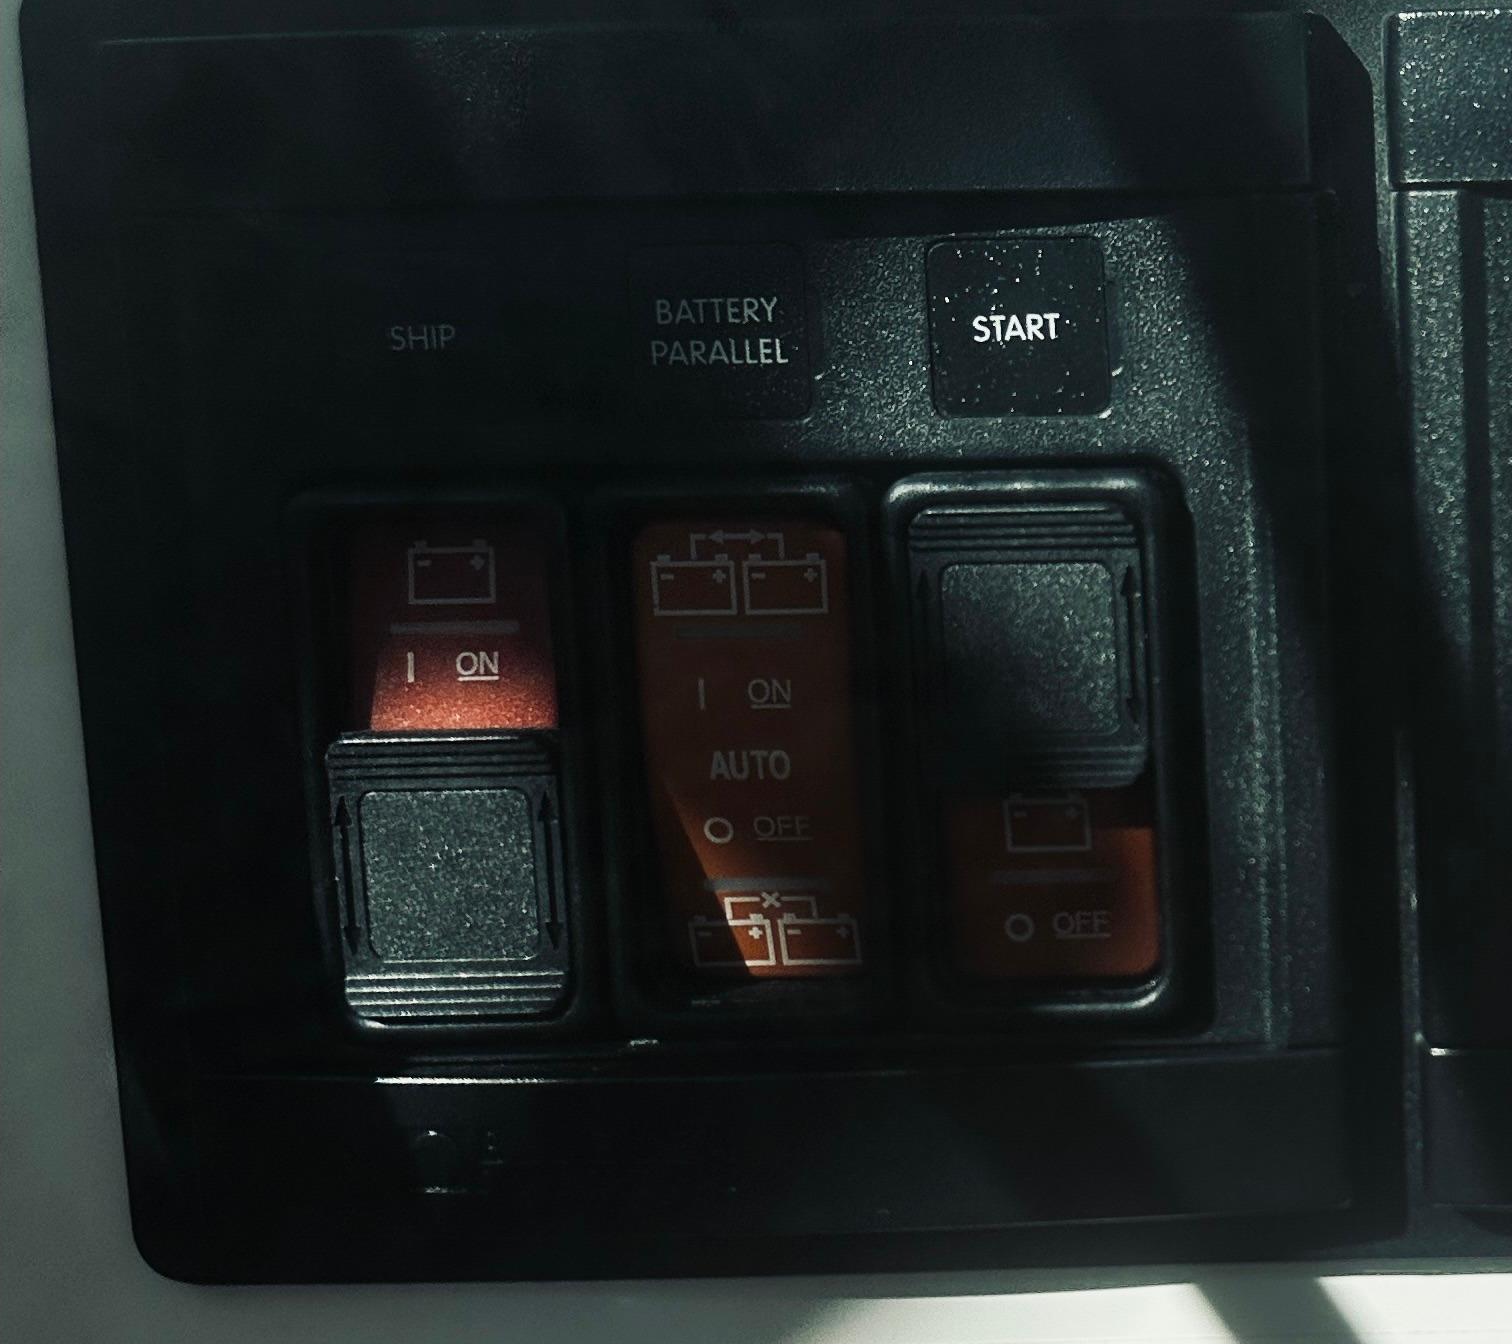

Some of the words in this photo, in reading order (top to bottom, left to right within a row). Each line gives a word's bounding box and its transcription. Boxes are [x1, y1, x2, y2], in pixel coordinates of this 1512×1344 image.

[655, 297, 780, 328] BATTERY
[971, 311, 1062, 343] START
[390, 321, 457, 353] SHIP
[649, 337, 789, 368] PARALLEL
[455, 648, 499, 682] ON
[748, 677, 793, 711] ON
[708, 749, 792, 781] AUTO
[751, 814, 812, 843] OFF
[1050, 910, 1111, 939] OFF
